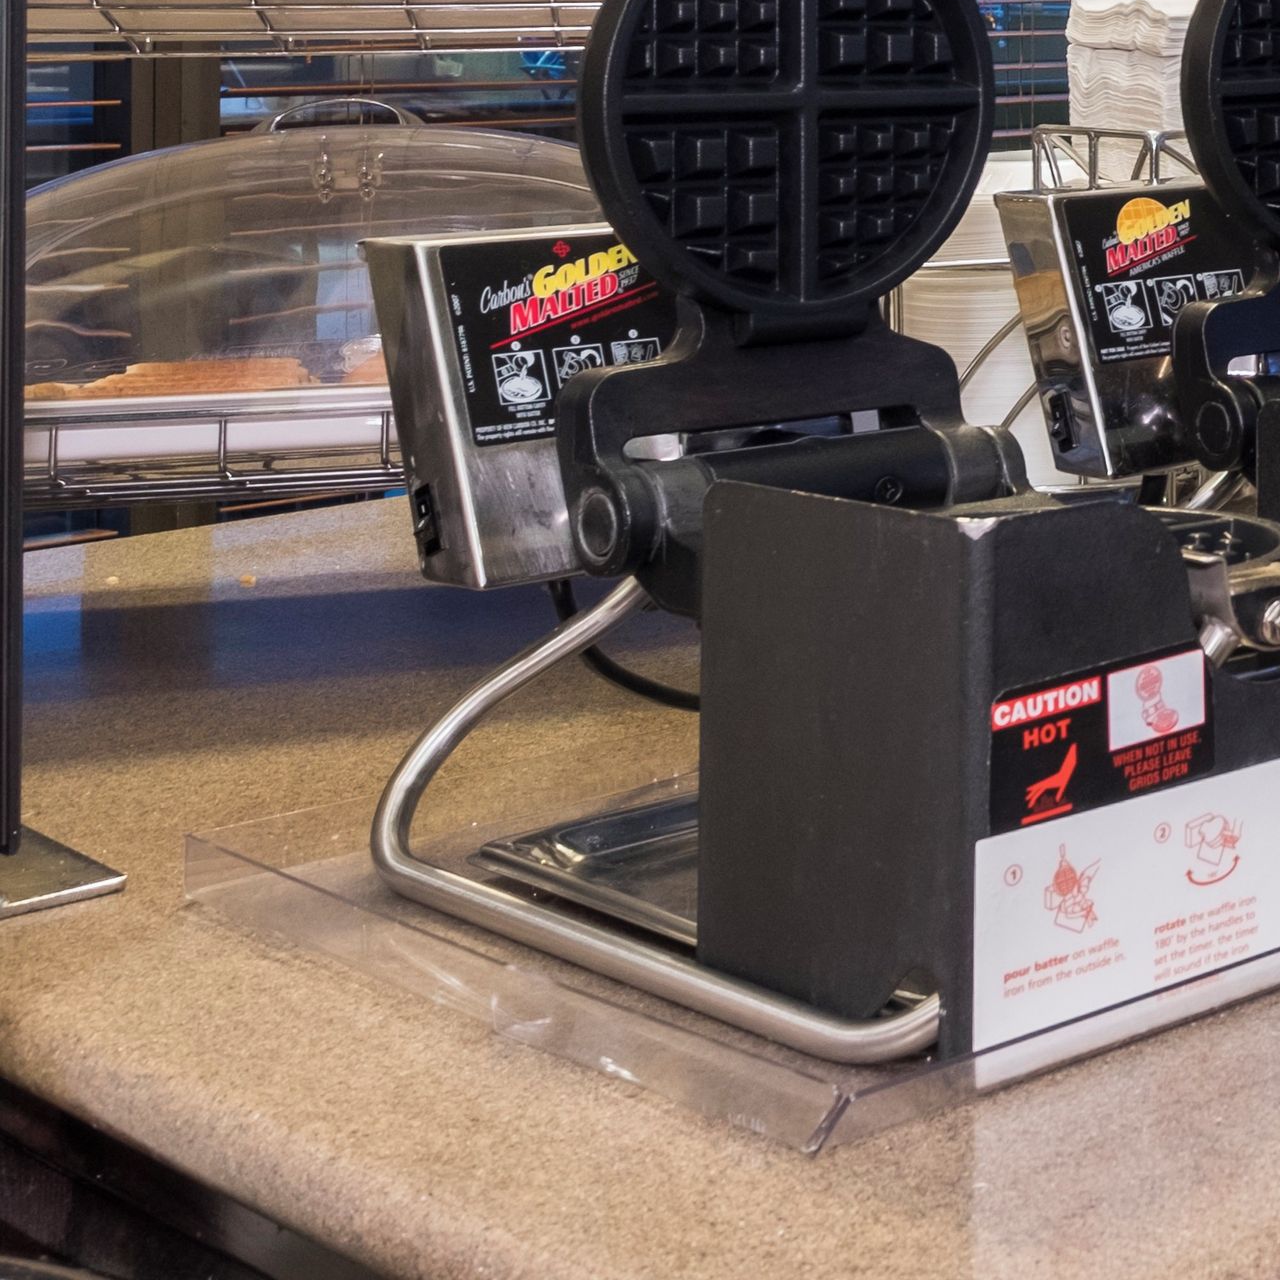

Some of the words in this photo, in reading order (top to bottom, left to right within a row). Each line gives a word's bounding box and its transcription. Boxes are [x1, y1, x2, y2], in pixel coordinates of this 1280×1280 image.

[1119, 199, 1191, 244] GOLDEN
[1106, 225, 1178, 273] MALTED
[1129, 257, 1161, 277] AMERICA'S
[1160, 245, 1186, 262] WAFFLE
[619, 265, 639, 280] SINCE
[620, 275, 638, 288] 1937
[510, 273, 619, 335] MALTED
[994, 679, 1099, 727] CAUTION
[1023, 718, 1072, 751] HOT
[1113, 749, 1143, 767] WHEN
[1145, 741, 1165, 758] NOT
[1167, 738, 1177, 750] IN
[1180, 731, 1201, 747] USE,
[1124, 757, 1160, 777] PLEASE
[1163, 746, 1193, 766] LEAVE
[1129, 771, 1160, 792] GRIDS
[1162, 763, 1188, 781] OPEN
[1154, 918, 1187, 934] rotate
[1189, 912, 1205, 924] the
[1207, 902, 1237, 917] waffle
[1238, 896, 1257, 907] iron
[1176, 933, 1188, 945] by
[1190, 927, 1206, 938] the
[1208, 916, 1243, 933] handles
[1245, 911, 1256, 921] to
[1003, 966, 1031, 984] pour
[1034, 953, 1070, 972] batter
[1072, 948, 1086, 960] on
[1088, 937, 1119, 956] waffle
[1154, 954, 1168, 966] set
[1170, 949, 1186, 960] the
[1218, 934, 1233, 945] the
[1235, 925, 1259, 940] timer
[1154, 966, 1171, 981] will
[1173, 957, 1202, 975] sound
[1204, 953, 1212, 964] if
[1214, 950, 1229, 961] the
[1231, 943, 1250, 956] iron
[1004, 984, 1025, 998] iron
[1028, 976, 1053, 991] from
[1056, 969, 1073, 981] the
[1075, 957, 1112, 976] outside
